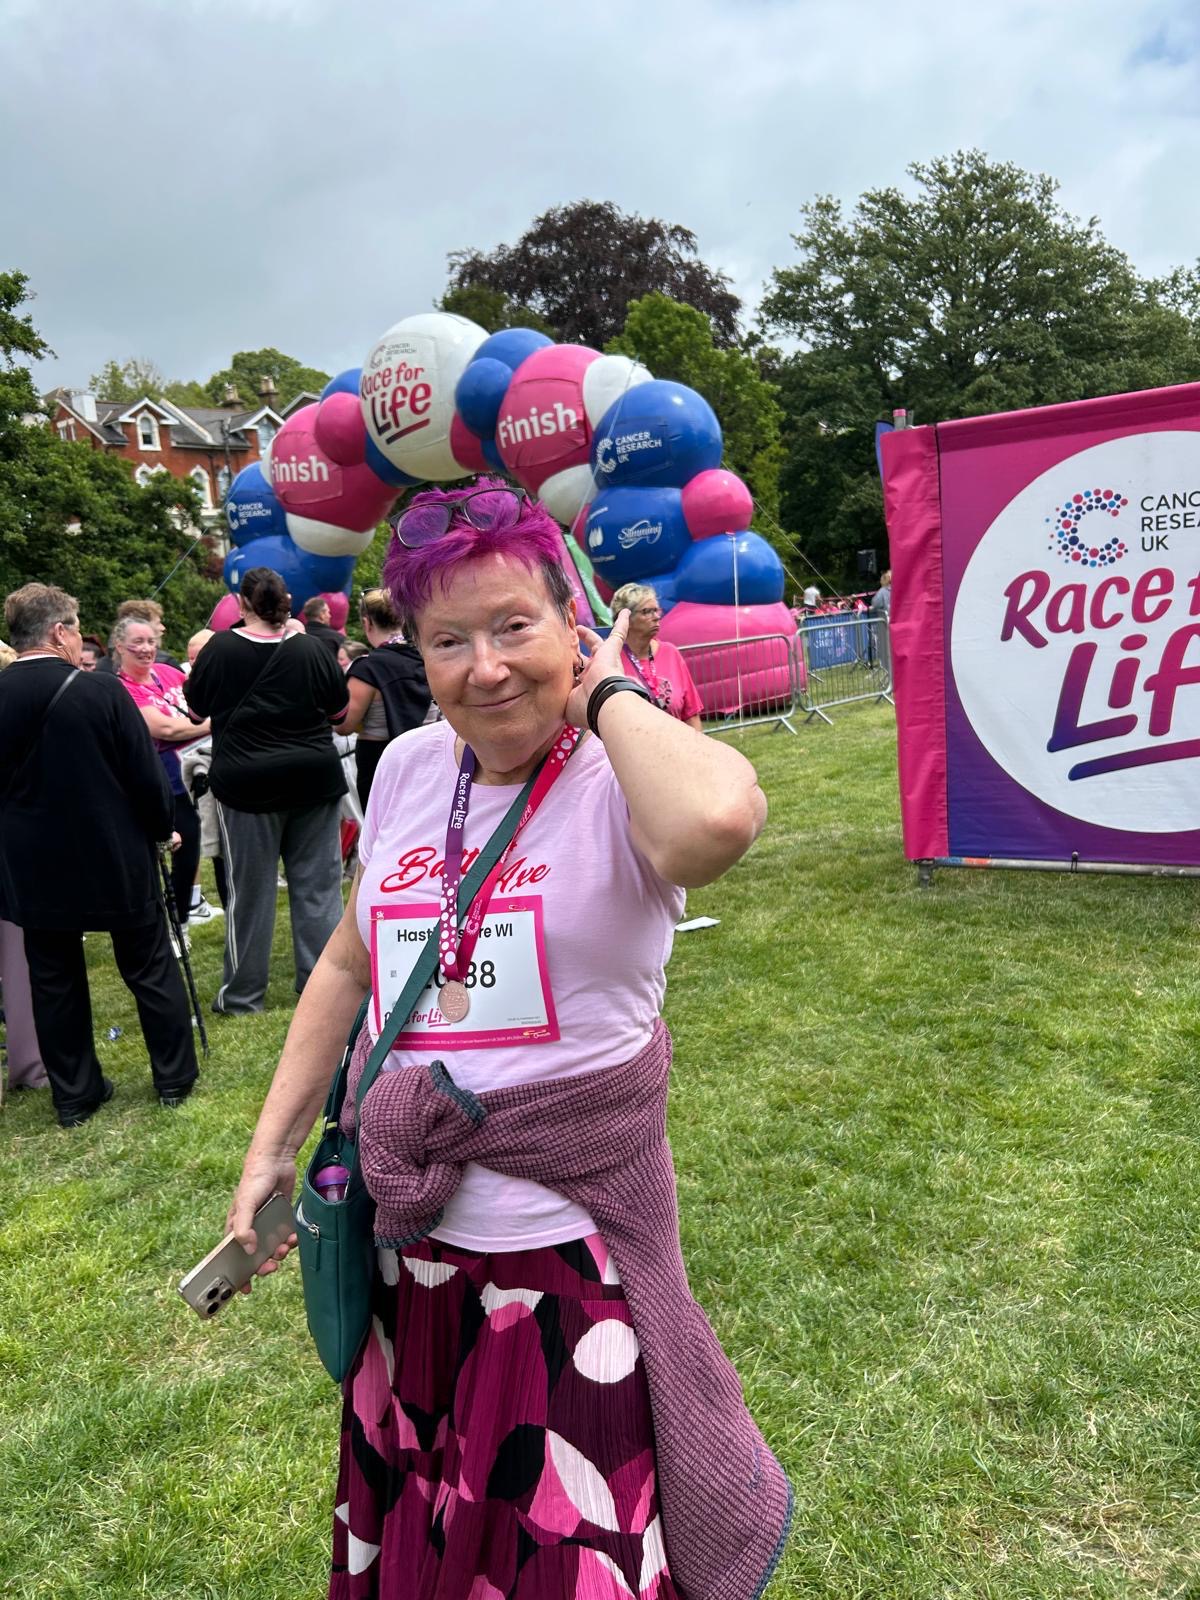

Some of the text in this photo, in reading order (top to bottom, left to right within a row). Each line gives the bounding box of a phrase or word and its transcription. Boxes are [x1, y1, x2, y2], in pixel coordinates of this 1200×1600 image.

[396, 362, 425, 384] for
[372, 383, 432, 436] Life
[498, 402, 578, 448] Finish
[615, 431, 650, 446] CANCER
[616, 439, 662, 455] RESEARCH
[617, 454, 630, 464] UK
[271, 455, 329, 482] inish
[238, 502, 263, 512] CANCER
[238, 508, 272, 518] RESEARCH
[1141, 512, 1200, 532] RESE
[1141, 534, 1169, 552] UK
[1000, 568, 1174, 648] Race
[454, 772, 471, 829] Race for Life
[495, 923, 513, 937] WI
[411, 1010, 427, 1024] for
